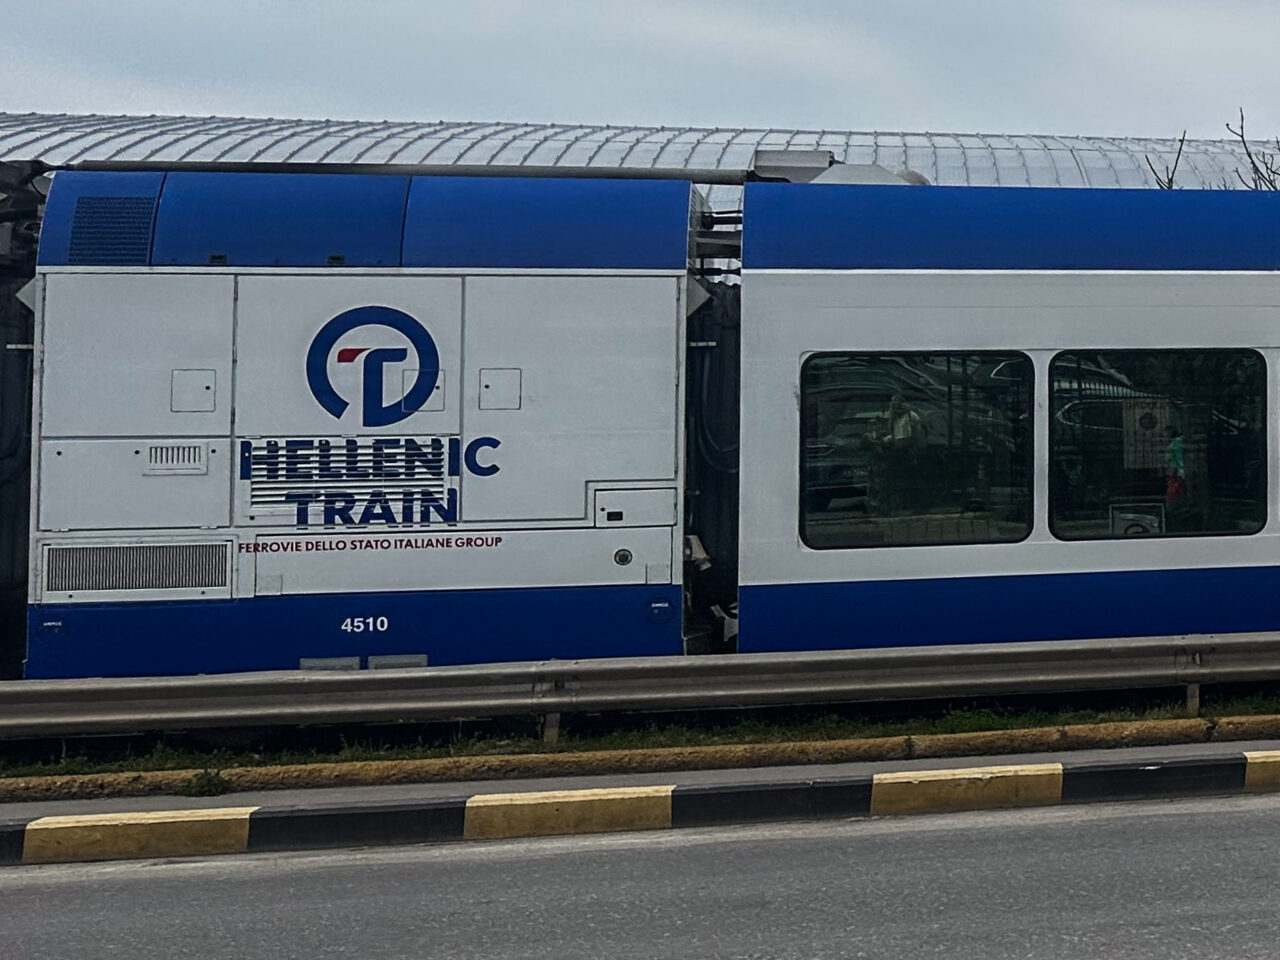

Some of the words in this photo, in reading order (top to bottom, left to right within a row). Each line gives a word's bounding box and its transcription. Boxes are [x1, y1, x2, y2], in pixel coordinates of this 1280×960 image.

[239, 436, 501, 480] HELLENIC
[285, 487, 458, 527] TRAIN
[237, 541, 302, 554] FERROVIE
[305, 540, 347, 552] DELLO
[350, 539, 391, 551] STATO
[394, 537, 453, 550] ITALIANE
[455, 536, 503, 548] GROUP
[340, 616, 389, 633] 4510
